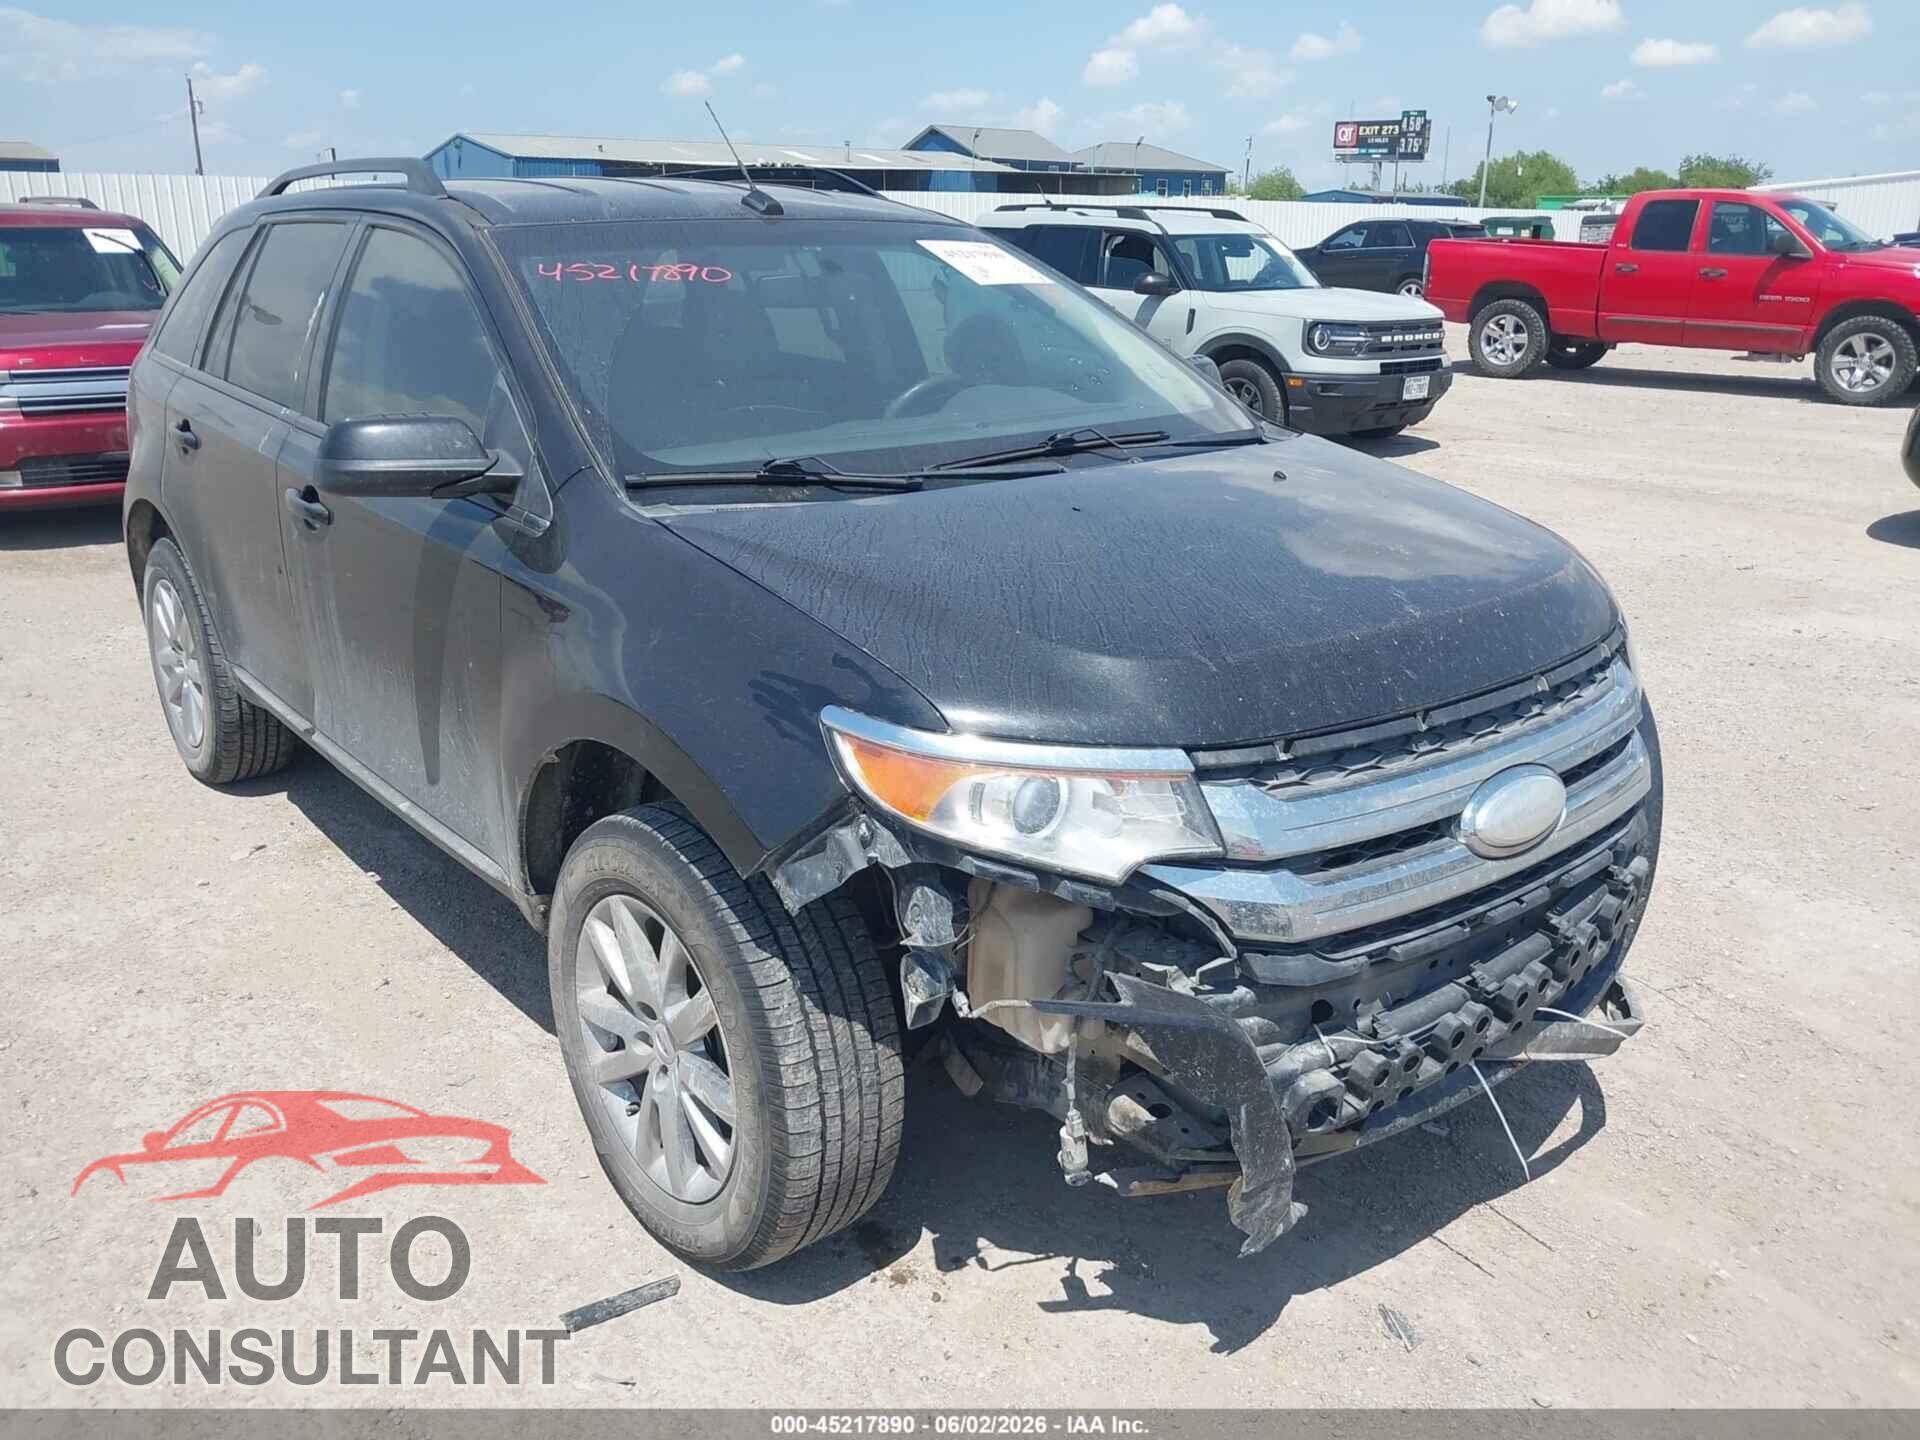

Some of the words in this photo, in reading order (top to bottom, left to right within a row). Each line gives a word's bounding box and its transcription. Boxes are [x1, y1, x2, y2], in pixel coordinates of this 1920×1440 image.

[1339, 127, 1354, 142] QT
[1359, 126, 1379, 135] EXIT
[1381, 125, 1399, 134] 273
[538, 262, 732, 282] 45217890
[1381, 332, 1440, 342] BRONCO
